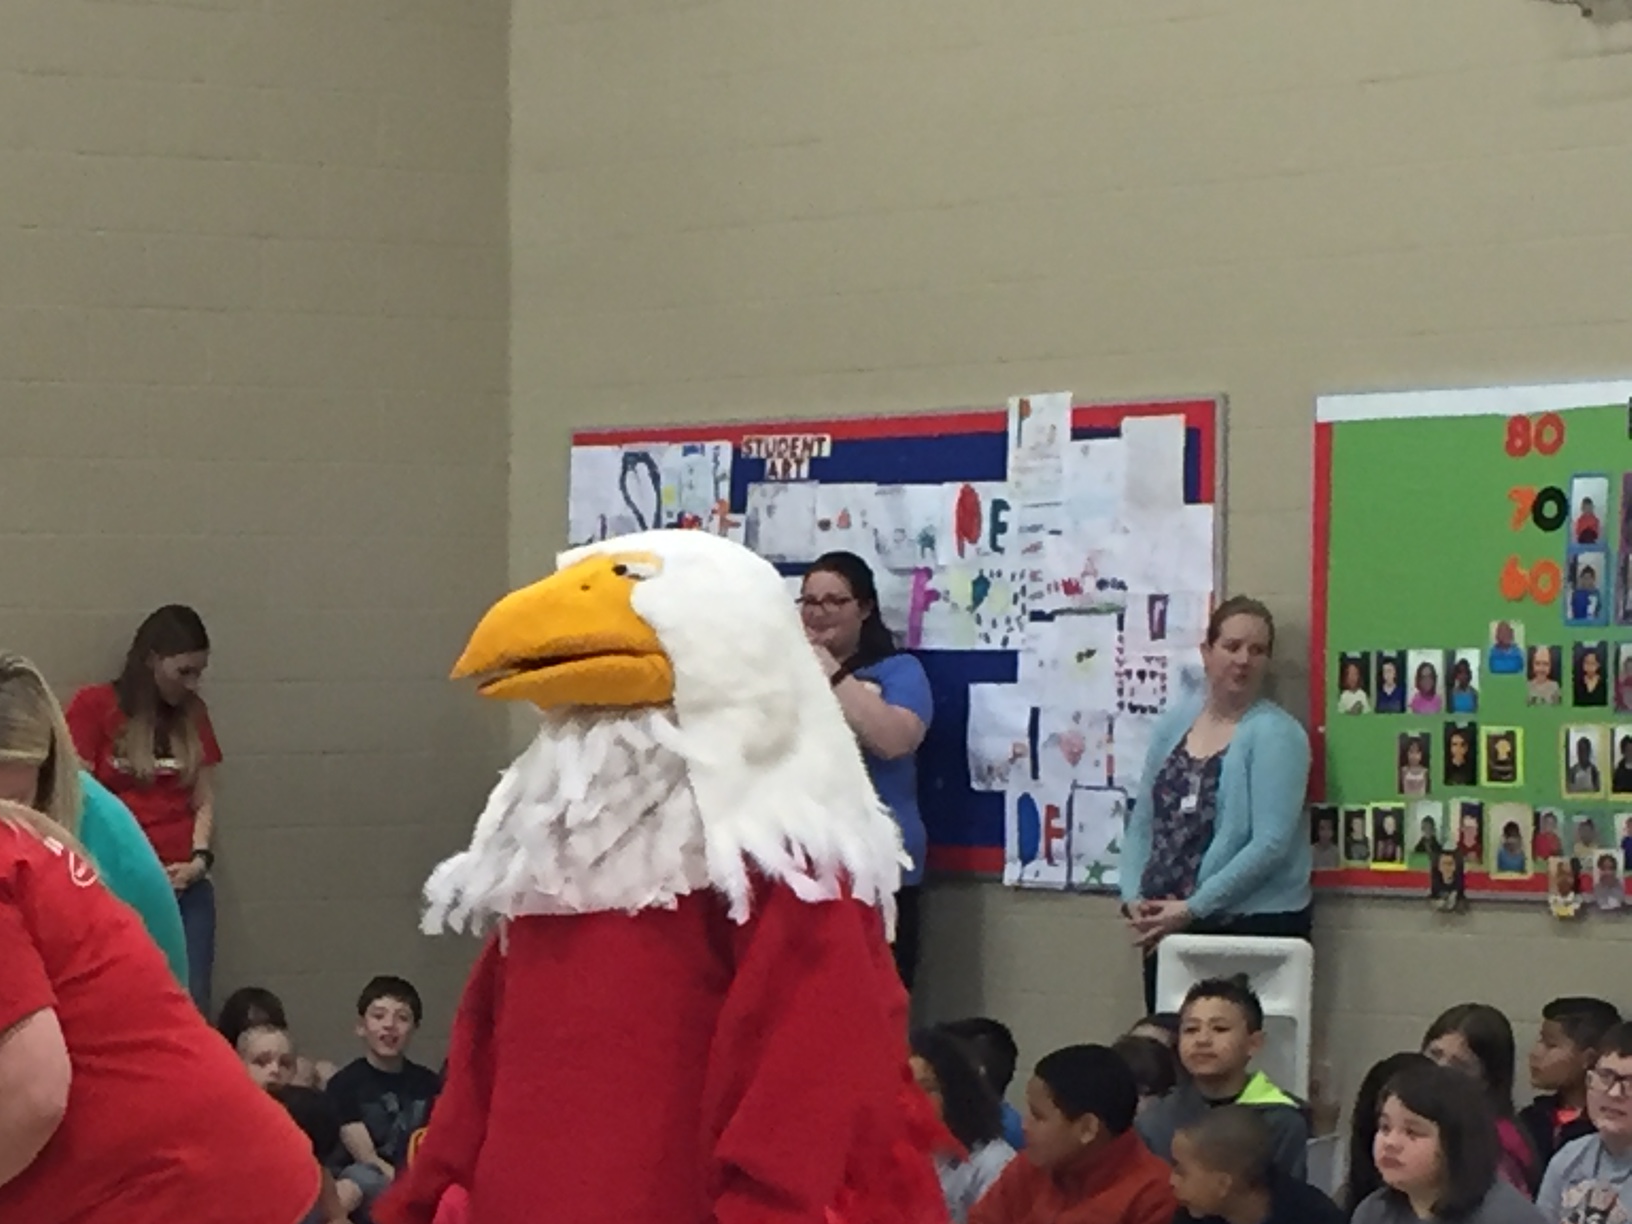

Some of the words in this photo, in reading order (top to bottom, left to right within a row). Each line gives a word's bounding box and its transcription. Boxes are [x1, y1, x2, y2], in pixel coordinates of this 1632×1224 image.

[742, 436, 827, 456] STUDENT
[1505, 411, 1565, 458] 80
[767, 457, 805, 479] ART
[1507, 485, 1568, 532] 70
[1499, 553, 1562, 605] 60
